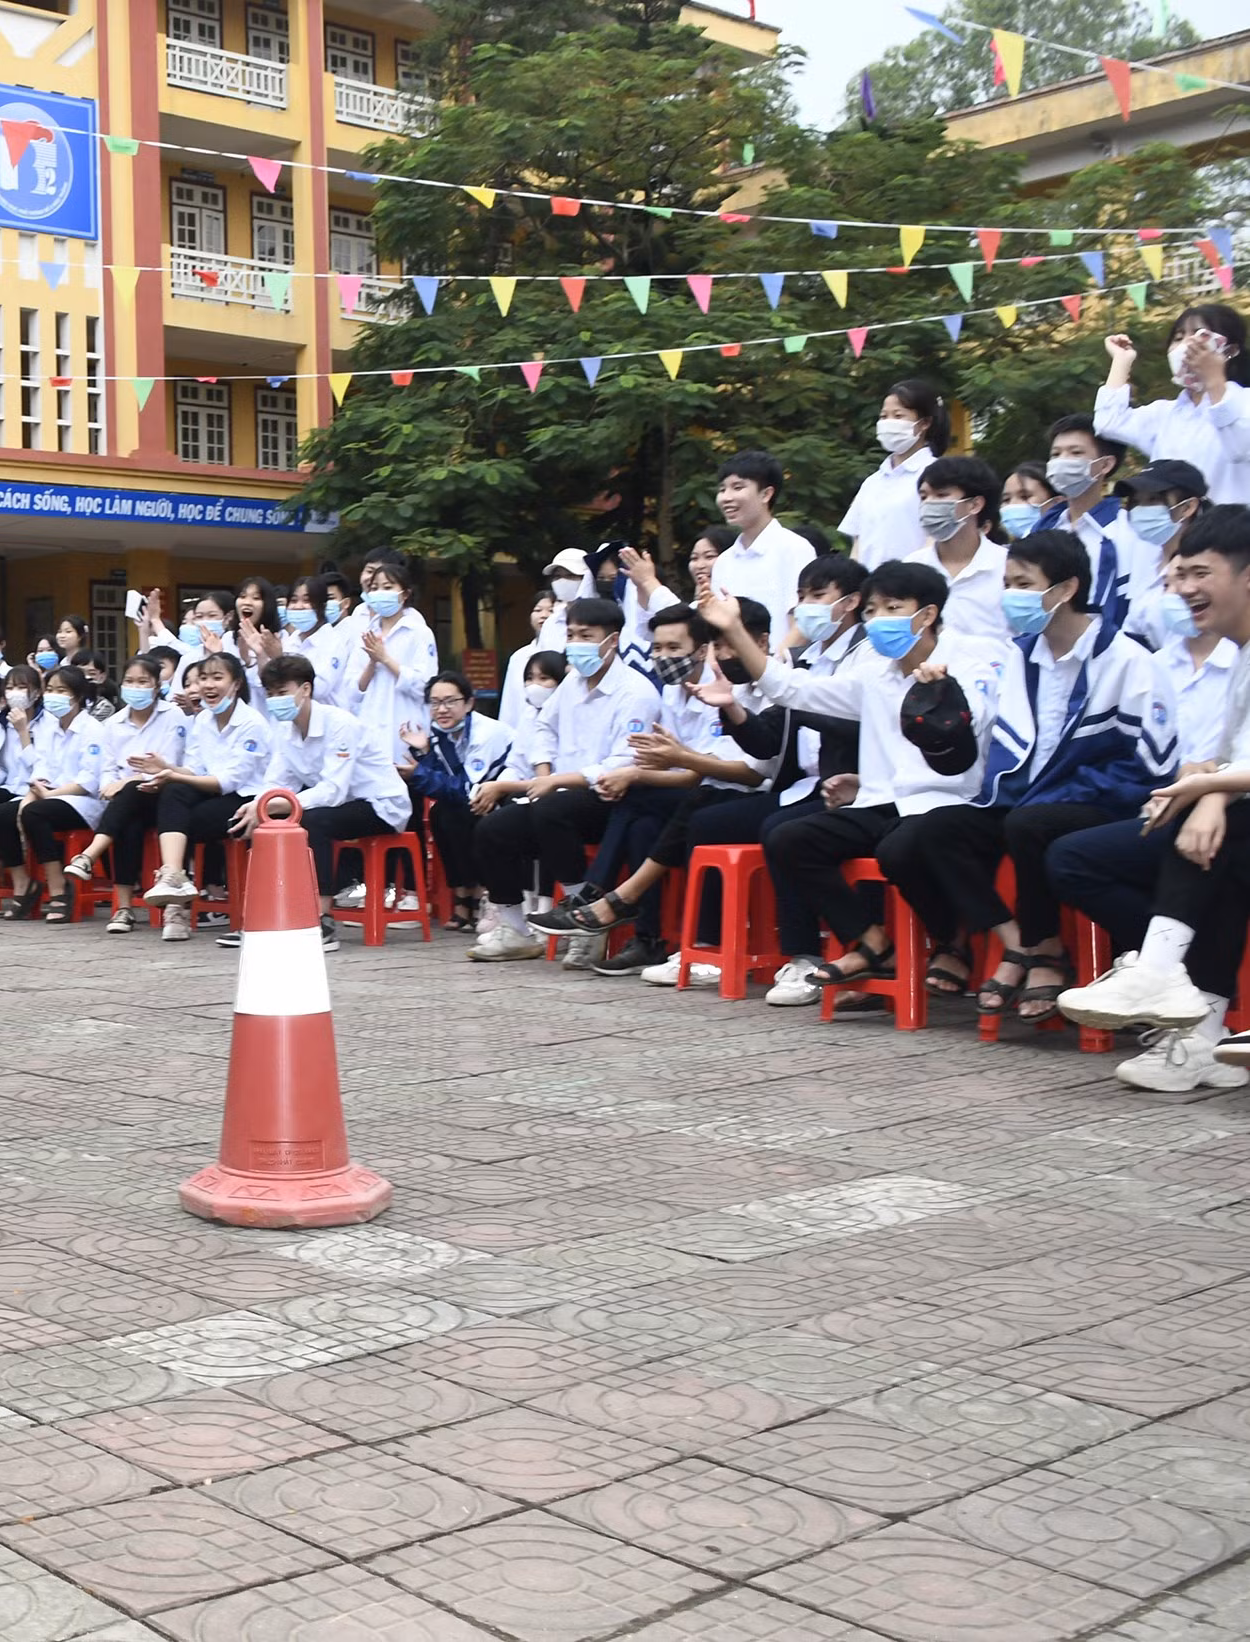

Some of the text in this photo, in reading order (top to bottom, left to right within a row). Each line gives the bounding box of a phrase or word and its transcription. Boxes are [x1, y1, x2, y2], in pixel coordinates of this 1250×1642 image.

[33, 488, 72, 515] SỐNG,
[75, 496, 102, 516] HỌC
[104, 495, 133, 515] LÀM
[134, 498, 175, 521] NGƯỜI,
[178, 503, 204, 522] HỌC
[205, 498, 225, 521] ĐỂ
[225, 506, 264, 524] CHUNG
